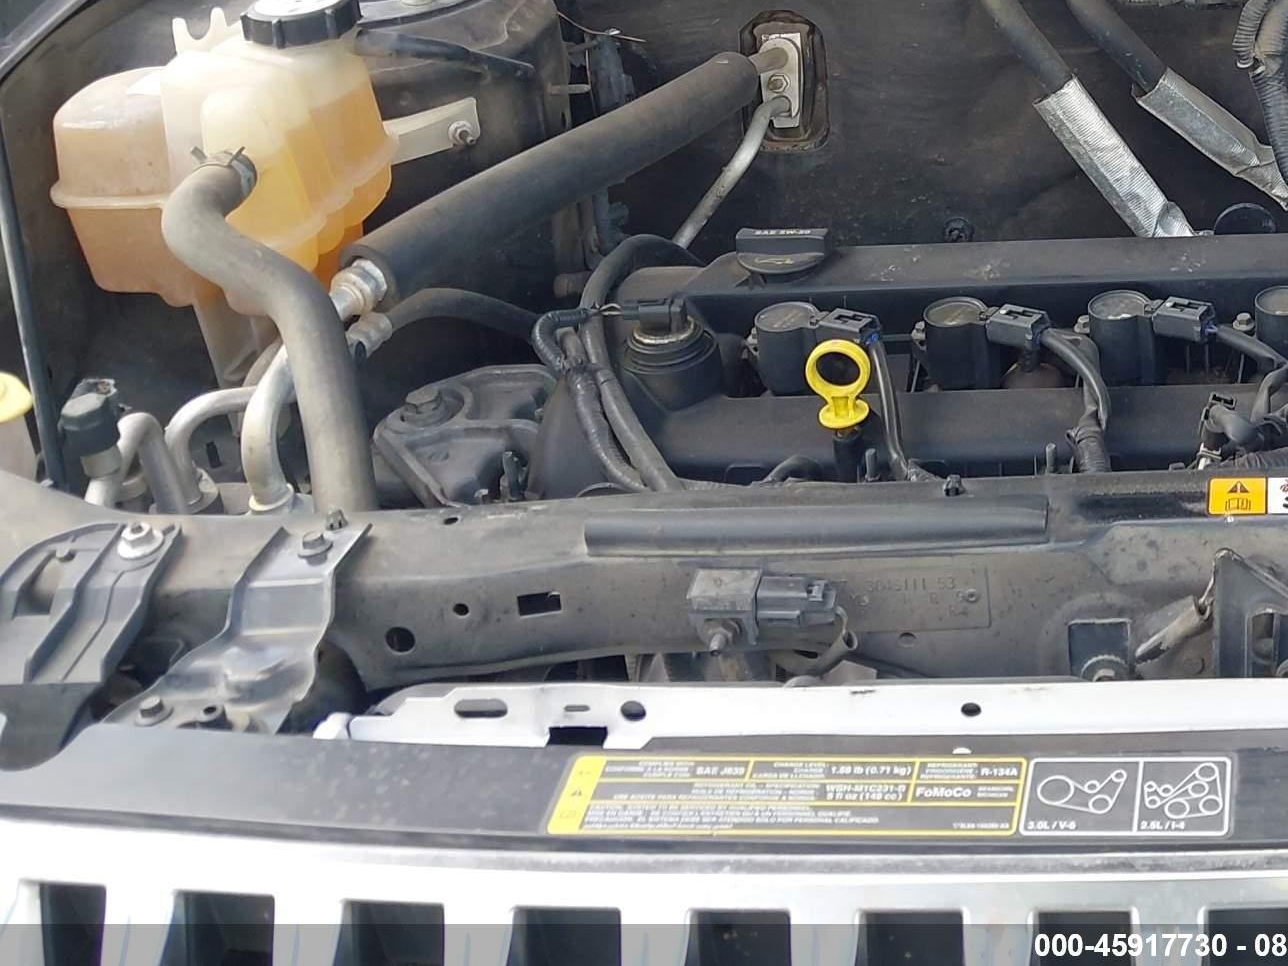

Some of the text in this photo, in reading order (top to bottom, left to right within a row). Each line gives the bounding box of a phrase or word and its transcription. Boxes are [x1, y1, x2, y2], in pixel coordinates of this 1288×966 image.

[696, 766, 718, 775] SAE
[853, 765, 863, 775] lb
[893, 765, 912, 777] kg)
[980, 767, 1018, 776] R-134A
[915, 786, 972, 797] FoMoCo
[1027, 820, 1050, 830] 3.0L
[1059, 820, 1077, 830] V-6
